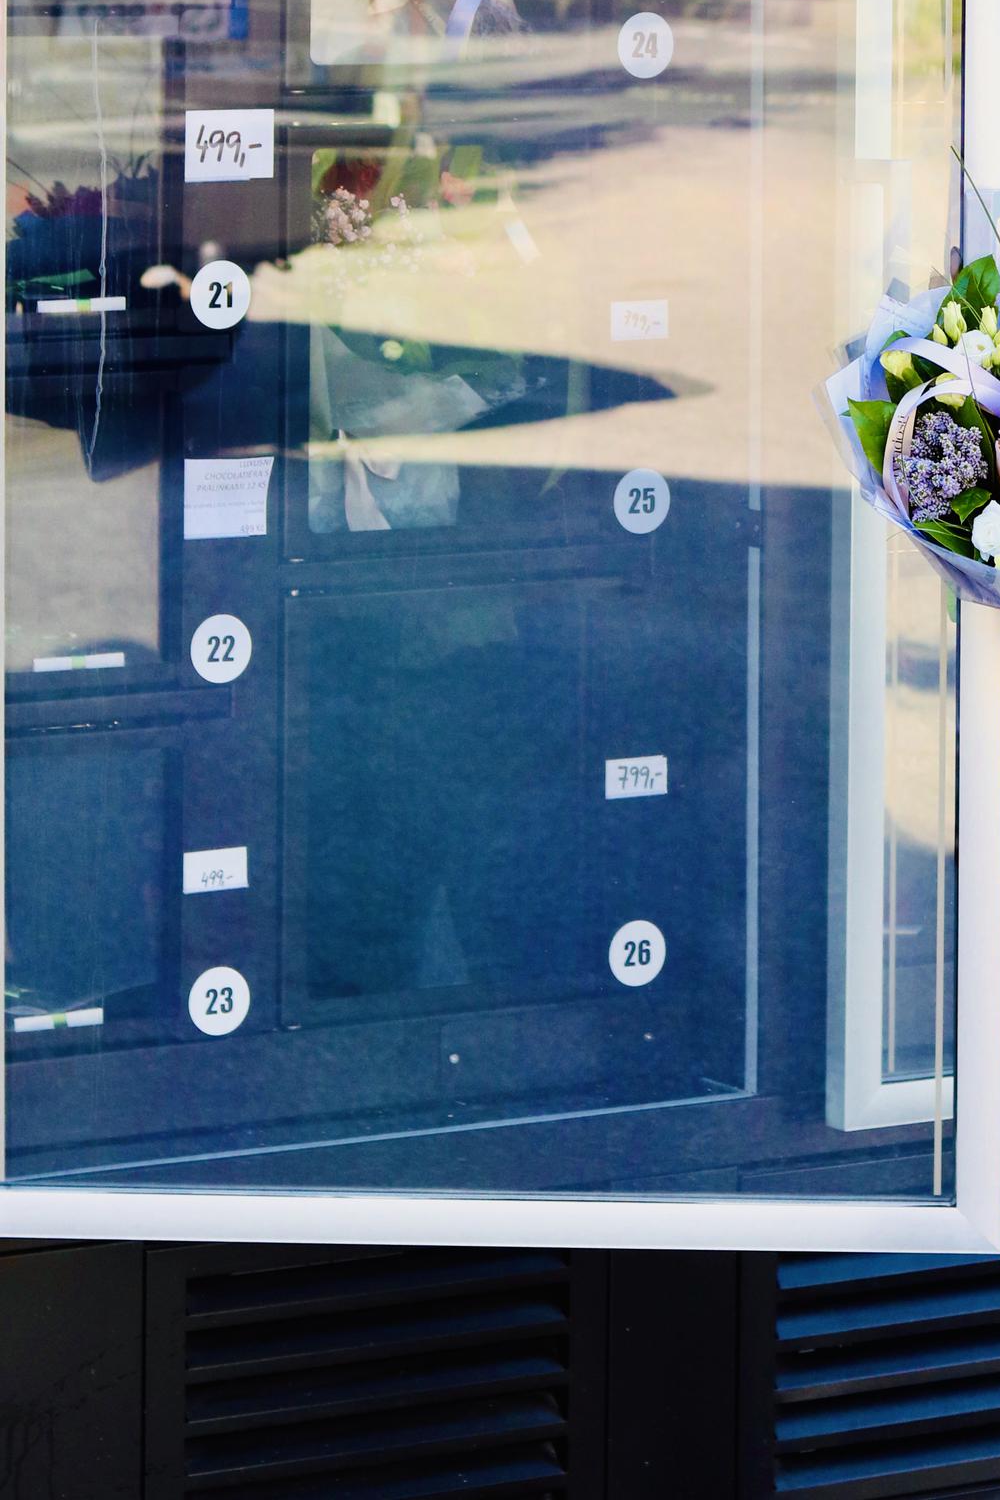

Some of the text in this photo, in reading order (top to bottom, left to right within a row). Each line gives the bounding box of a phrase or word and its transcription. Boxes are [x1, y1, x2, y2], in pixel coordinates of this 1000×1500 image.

[631, 31, 660, 60] 24
[196, 124, 263, 168] 499,-
[208, 281, 234, 309] 21
[628, 487, 656, 515] 25
[207, 635, 236, 663] 22
[617, 765, 663, 790] 799,-
[624, 939, 651, 967] 26
[205, 986, 234, 1016] 23
